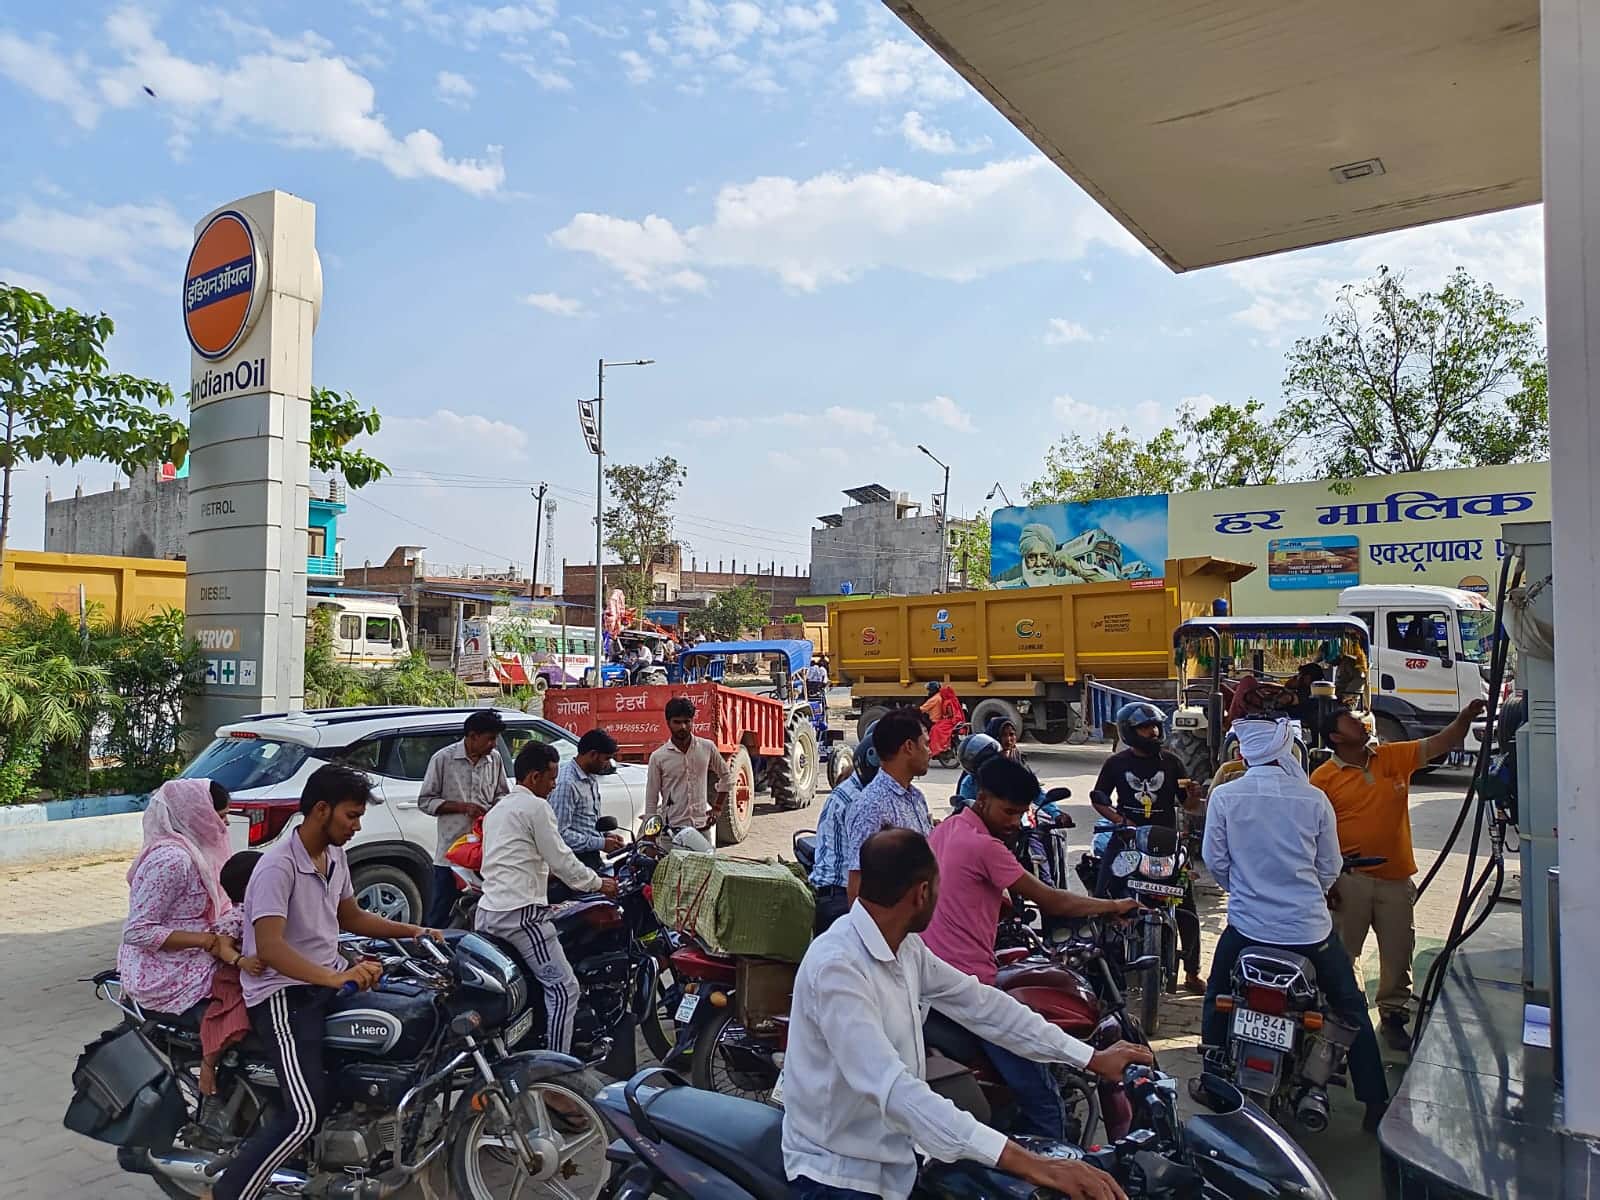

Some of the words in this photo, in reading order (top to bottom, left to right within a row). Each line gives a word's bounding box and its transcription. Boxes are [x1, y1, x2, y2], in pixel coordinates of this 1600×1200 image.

[187, 264, 251, 309] इंडियनऑयल
[191, 359, 265, 405] IndianOil
[201, 500, 236, 517] PETROL
[1213, 509, 1286, 534] हर
[1315, 491, 1537, 527] मालिक
[200, 586, 232, 600] DIESEL
[556, 698, 590, 716] गोपाल
[615, 691, 649, 713] ट्रेडर्स
[1245, 1011, 1287, 1032] UP84A
